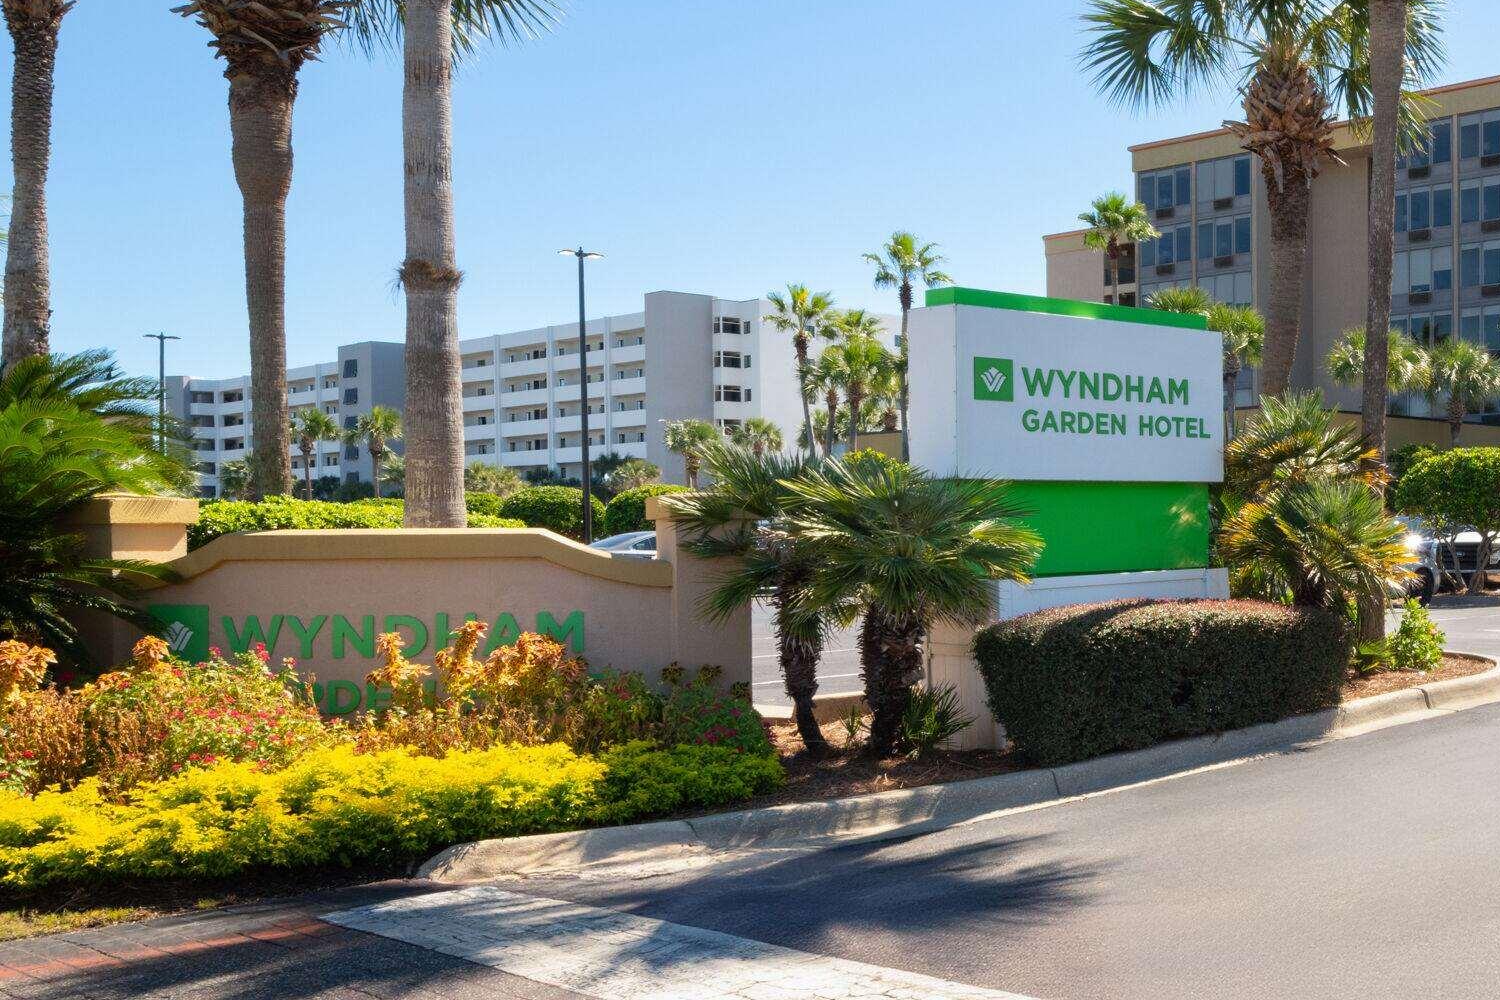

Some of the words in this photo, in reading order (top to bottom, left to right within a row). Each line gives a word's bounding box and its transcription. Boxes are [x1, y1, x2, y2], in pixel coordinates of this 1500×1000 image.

[1021, 366, 1189, 405] WYNDHAM
[1022, 409, 1126, 435] GARDEN
[1139, 415, 1211, 438] HOTEL
